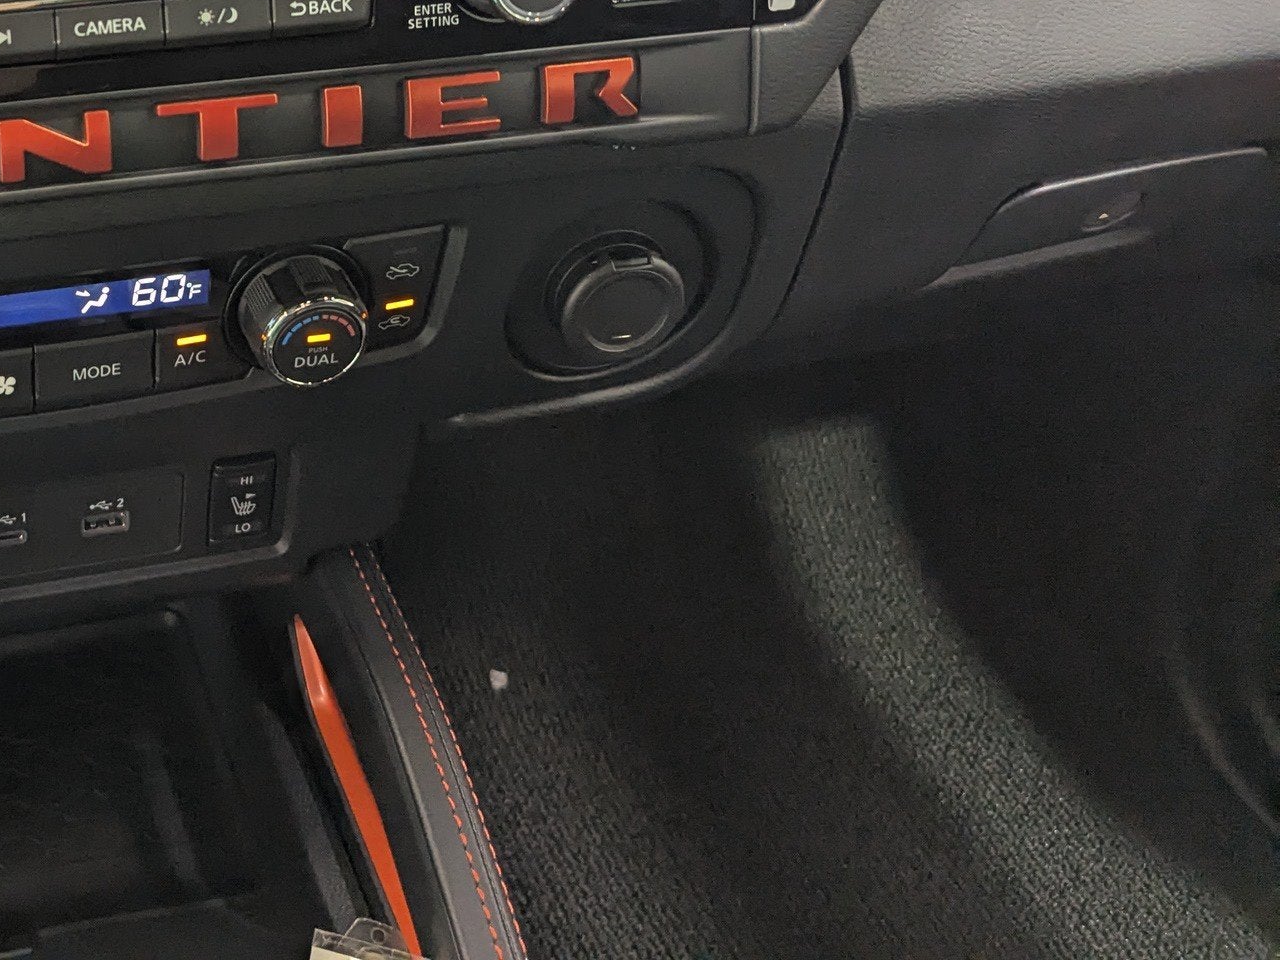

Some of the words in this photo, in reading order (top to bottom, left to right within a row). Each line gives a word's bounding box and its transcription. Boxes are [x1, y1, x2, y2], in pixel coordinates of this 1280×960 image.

[413, 2, 452, 16] ENTER
[74, 15, 147, 38] CAMERA
[407, 13, 460, 30] SETTING
[308, 345, 329, 354] PUSH
[173, 349, 207, 368] A/C
[294, 352, 340, 369] DUAL
[72, 362, 122, 382] MODE
[239, 474, 254, 486] HI
[116, 497, 125, 509] 2
[20, 512, 27, 523] 1
[234, 521, 252, 534] LO
